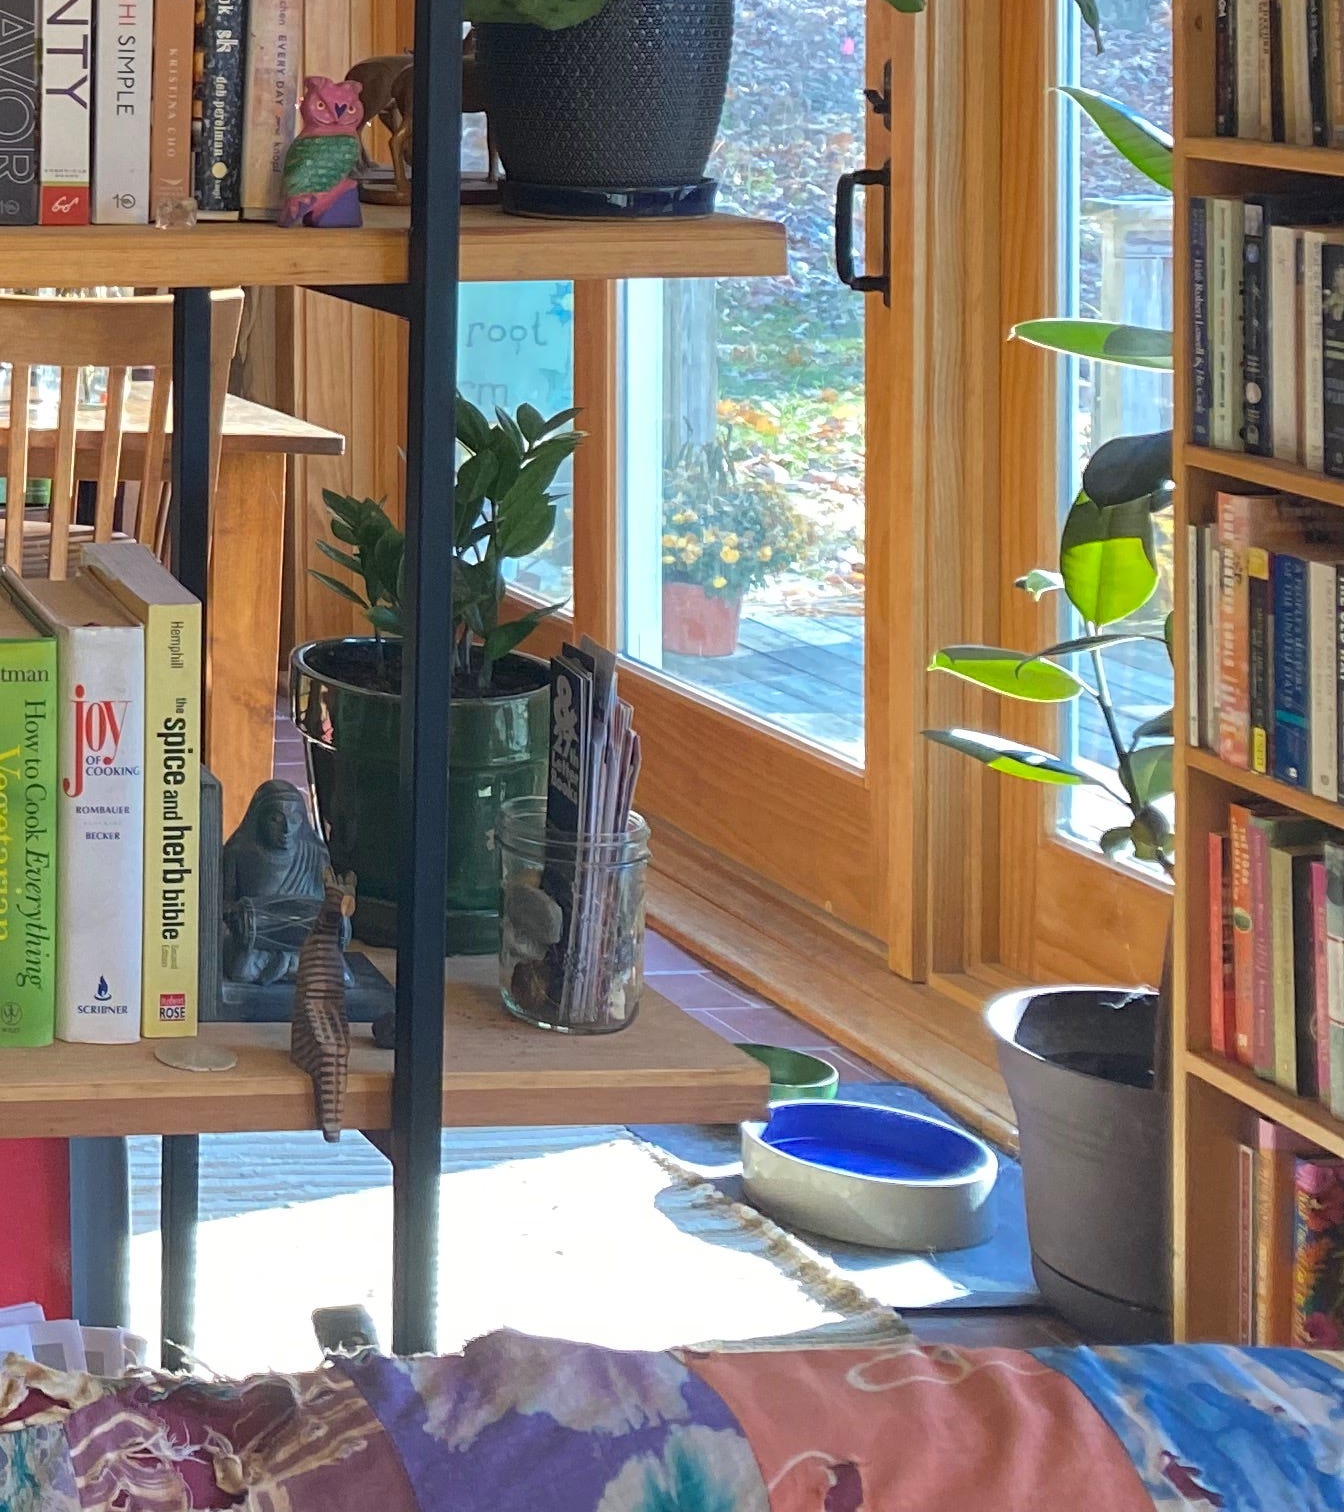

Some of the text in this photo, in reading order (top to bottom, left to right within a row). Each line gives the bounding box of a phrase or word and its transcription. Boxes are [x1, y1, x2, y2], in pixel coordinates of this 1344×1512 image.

[116, 34, 137, 117] SIMPLE
[169, 620, 184, 669] Hemphill
[157, 717, 193, 940] spice and herb bible
[78, 1005, 128, 1015] SCRIBNER
